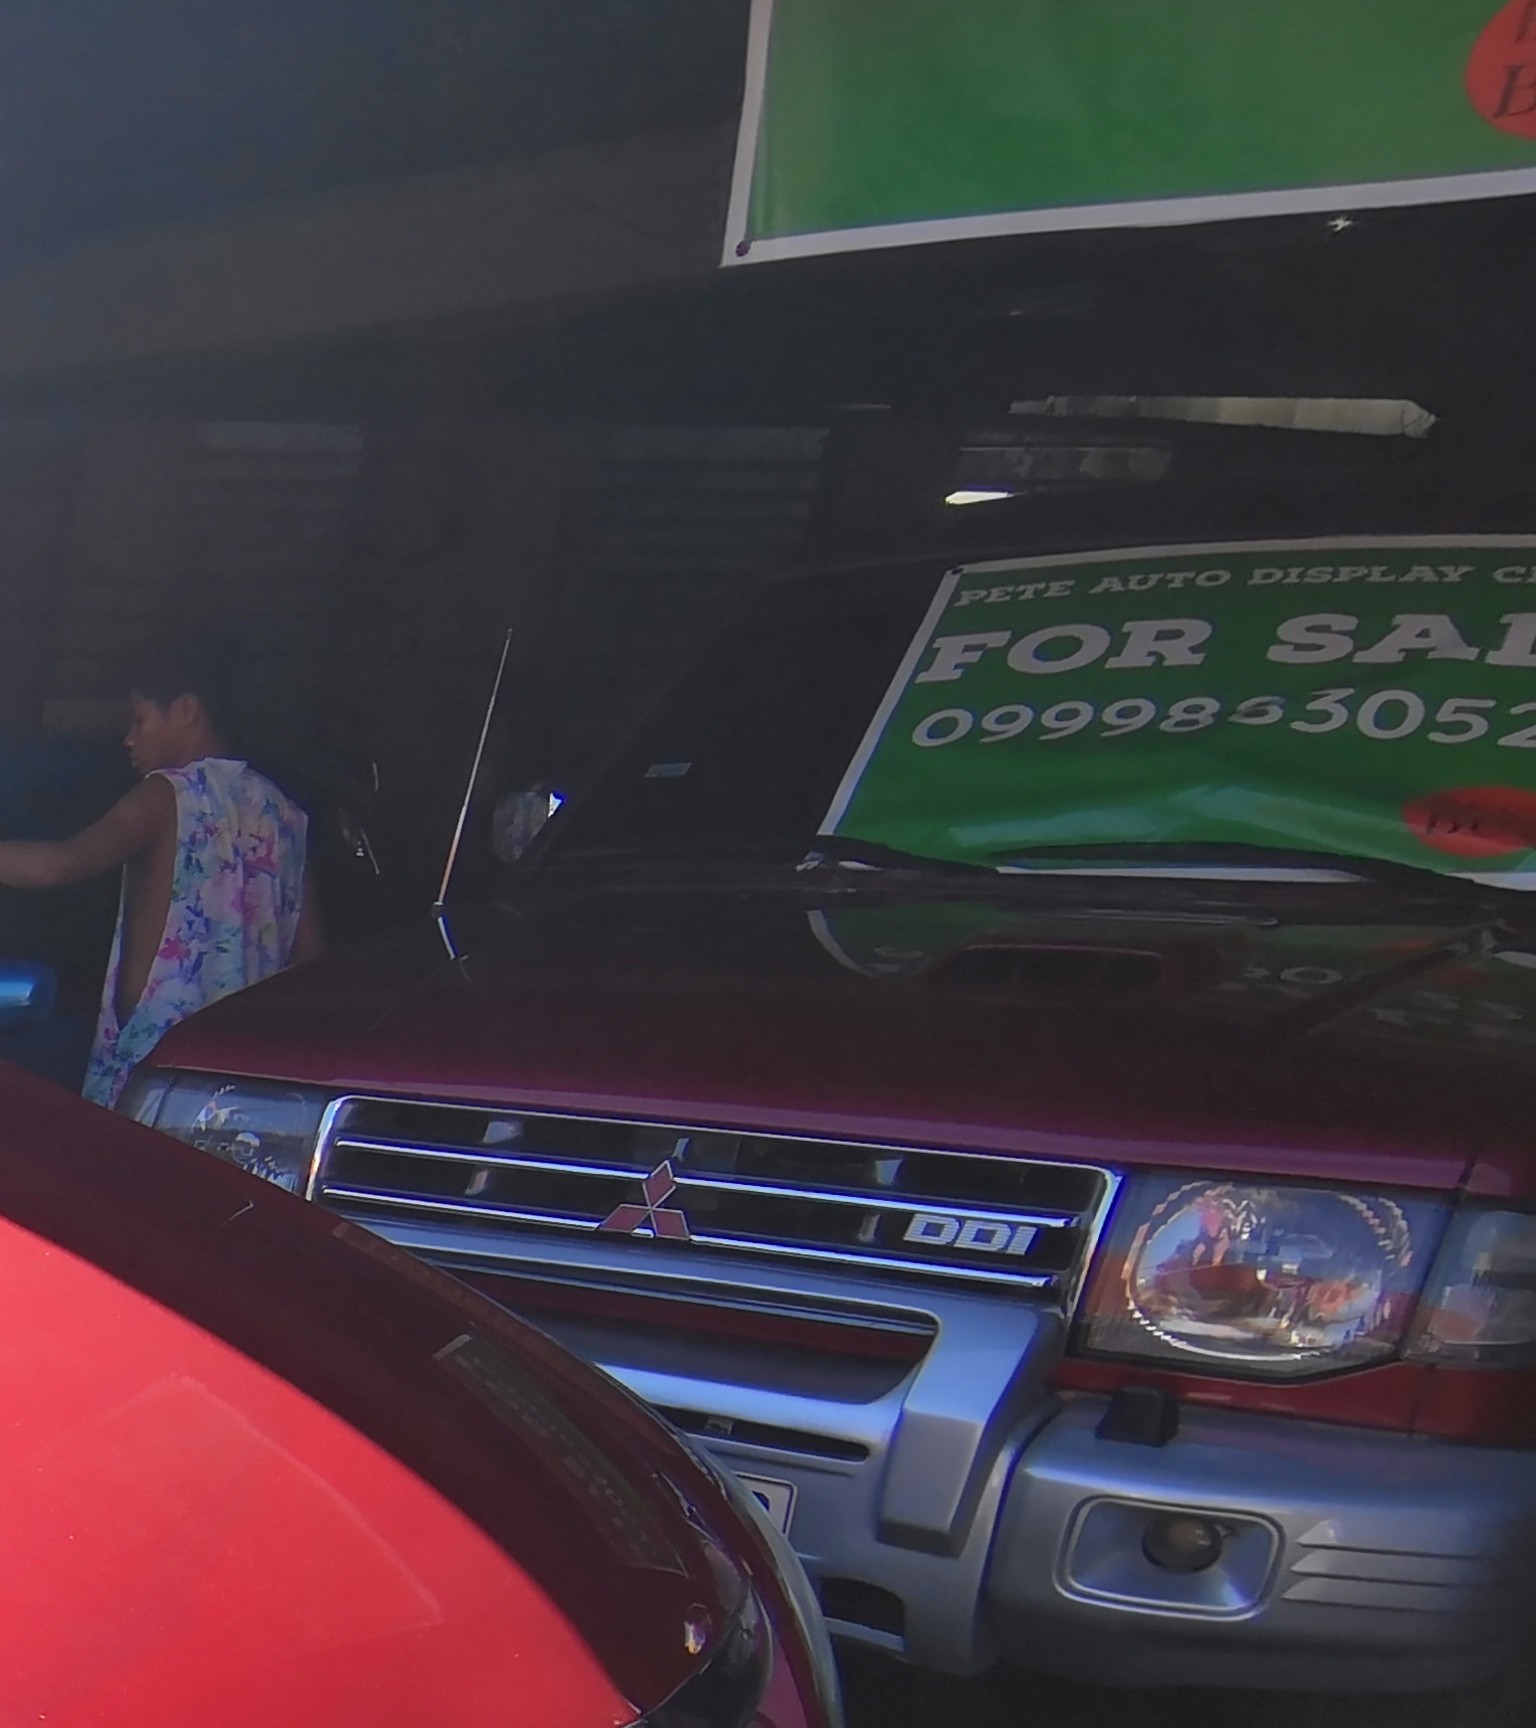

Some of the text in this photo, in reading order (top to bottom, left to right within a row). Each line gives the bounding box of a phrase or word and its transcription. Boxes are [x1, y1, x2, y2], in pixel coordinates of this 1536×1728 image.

[954, 580, 1074, 608] PETE
[1089, 569, 1232, 596] AUTO
[1245, 565, 1477, 588] DISPLAY
[912, 618, 1214, 685] FOR
[902, 1213, 1038, 1256] DDI
